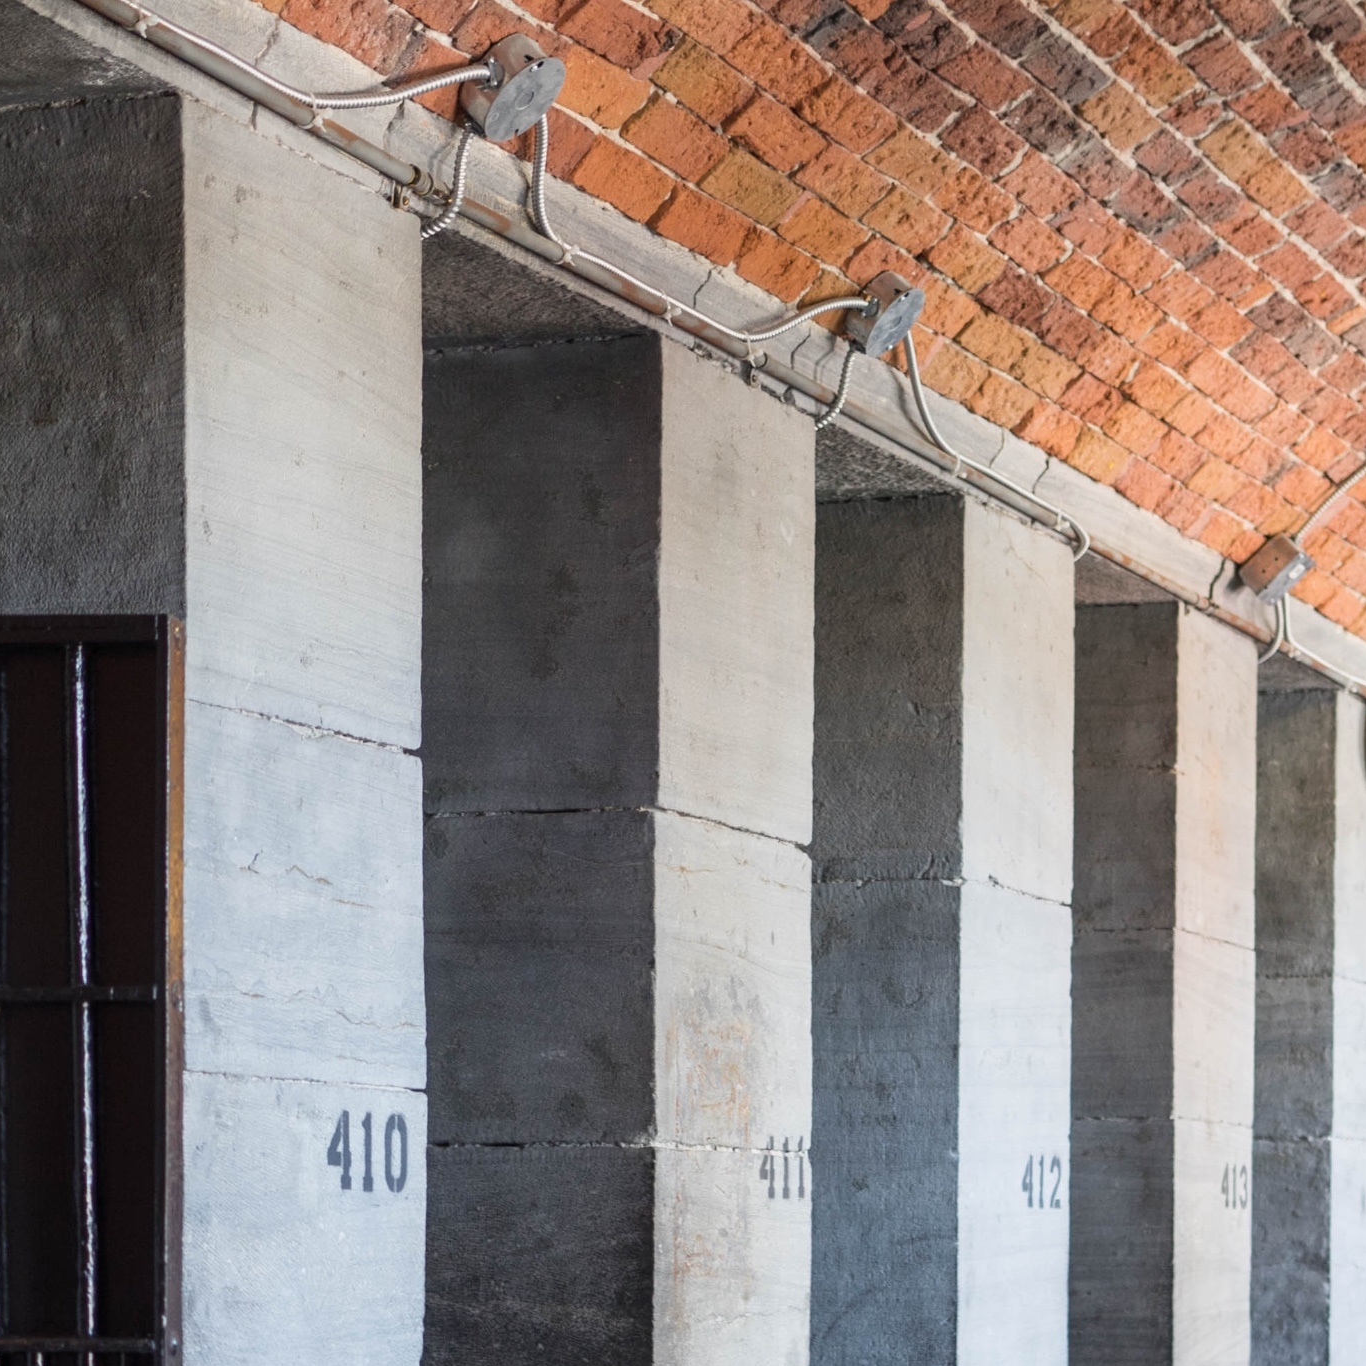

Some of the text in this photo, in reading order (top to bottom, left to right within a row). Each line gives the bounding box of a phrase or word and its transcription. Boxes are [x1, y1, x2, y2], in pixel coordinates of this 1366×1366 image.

[327, 1109, 408, 1193] 410
[759, 1136, 805, 1199] 411
[1021, 1154, 1061, 1208] 412
[1221, 1163, 1248, 1209] 413
